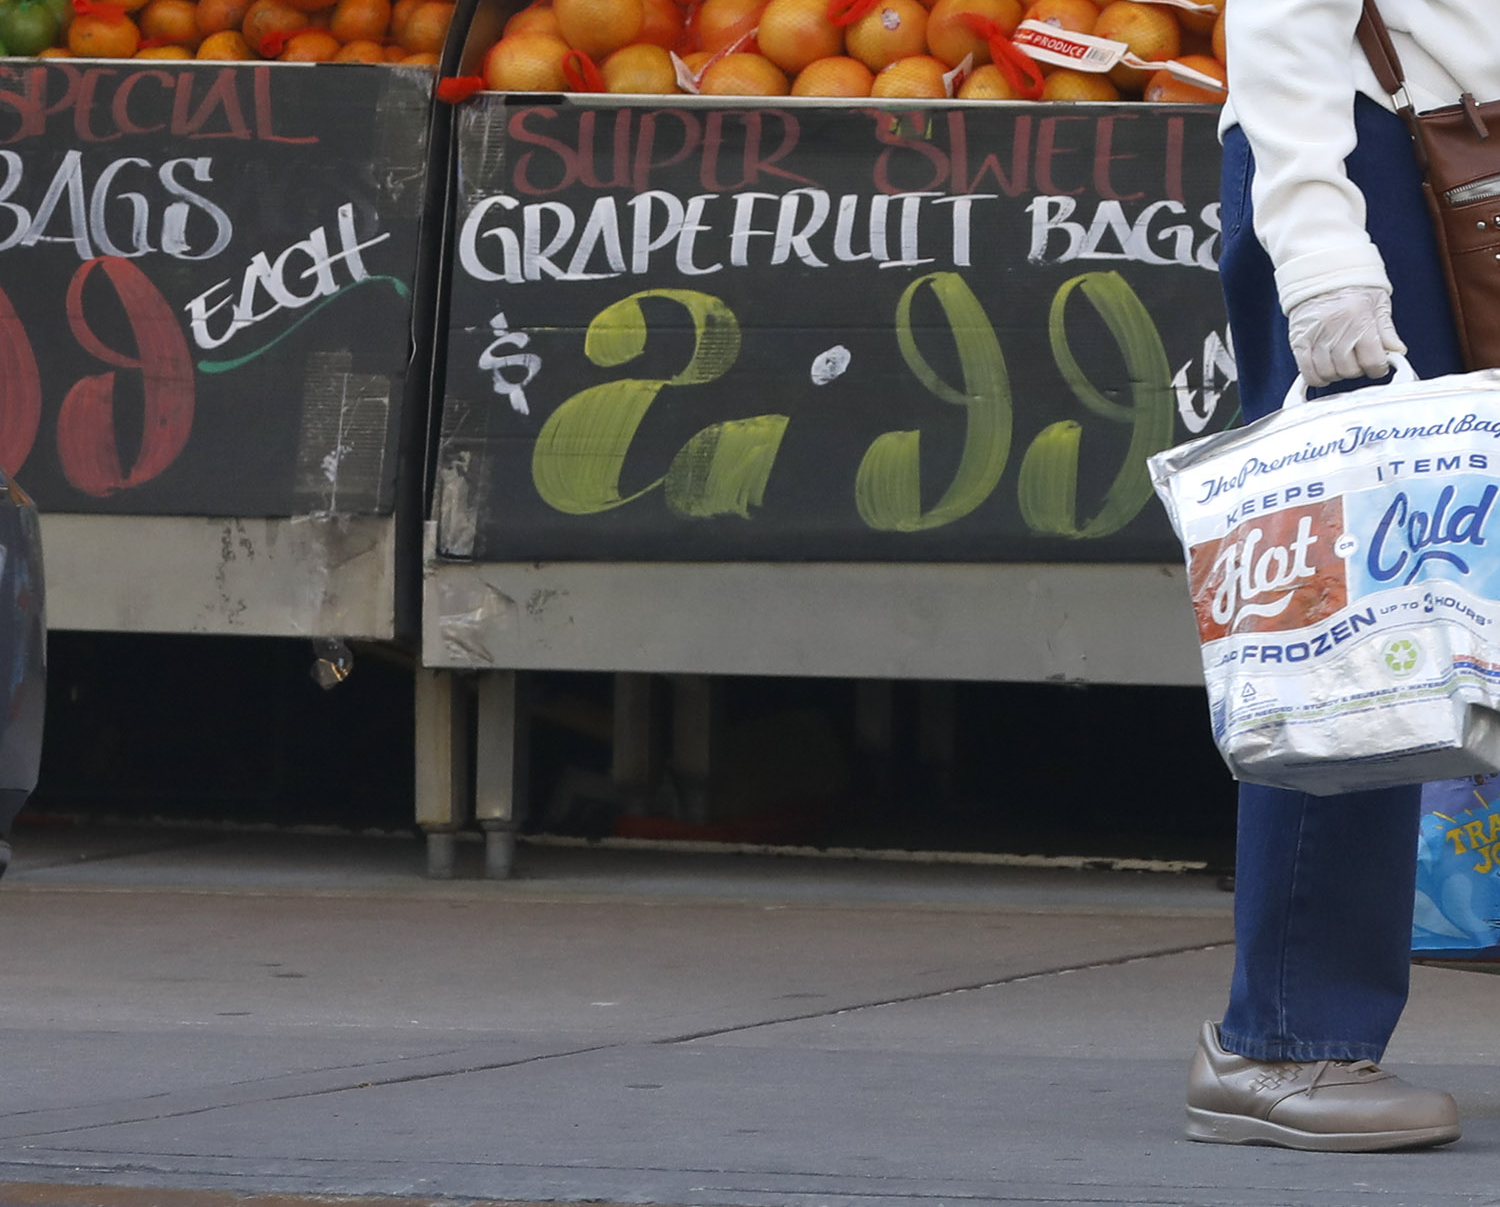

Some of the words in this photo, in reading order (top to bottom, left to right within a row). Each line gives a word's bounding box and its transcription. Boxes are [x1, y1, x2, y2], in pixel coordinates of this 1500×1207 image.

[1032, 34, 1085, 58] PRODUCE
[508, 106, 818, 194] SUPER
[865, 105, 1223, 205] SWEET
[184, 202, 391, 350] EACH
[459, 187, 999, 284] GRAPEFRUIT
[1197, 476, 1238, 504] The
[1237, 438, 1345, 488] Premium
[1340, 417, 1455, 454] Thermal
[1226, 481, 1325, 529] KEEPS
[1377, 454, 1488, 482] ITEMS
[1211, 515, 1319, 625] Hot
[1367, 484, 1499, 582] Cold
[1240, 607, 1377, 664] FROZEN
[1380, 605, 1398, 614] UP
[1401, 602, 1419, 610] TO
